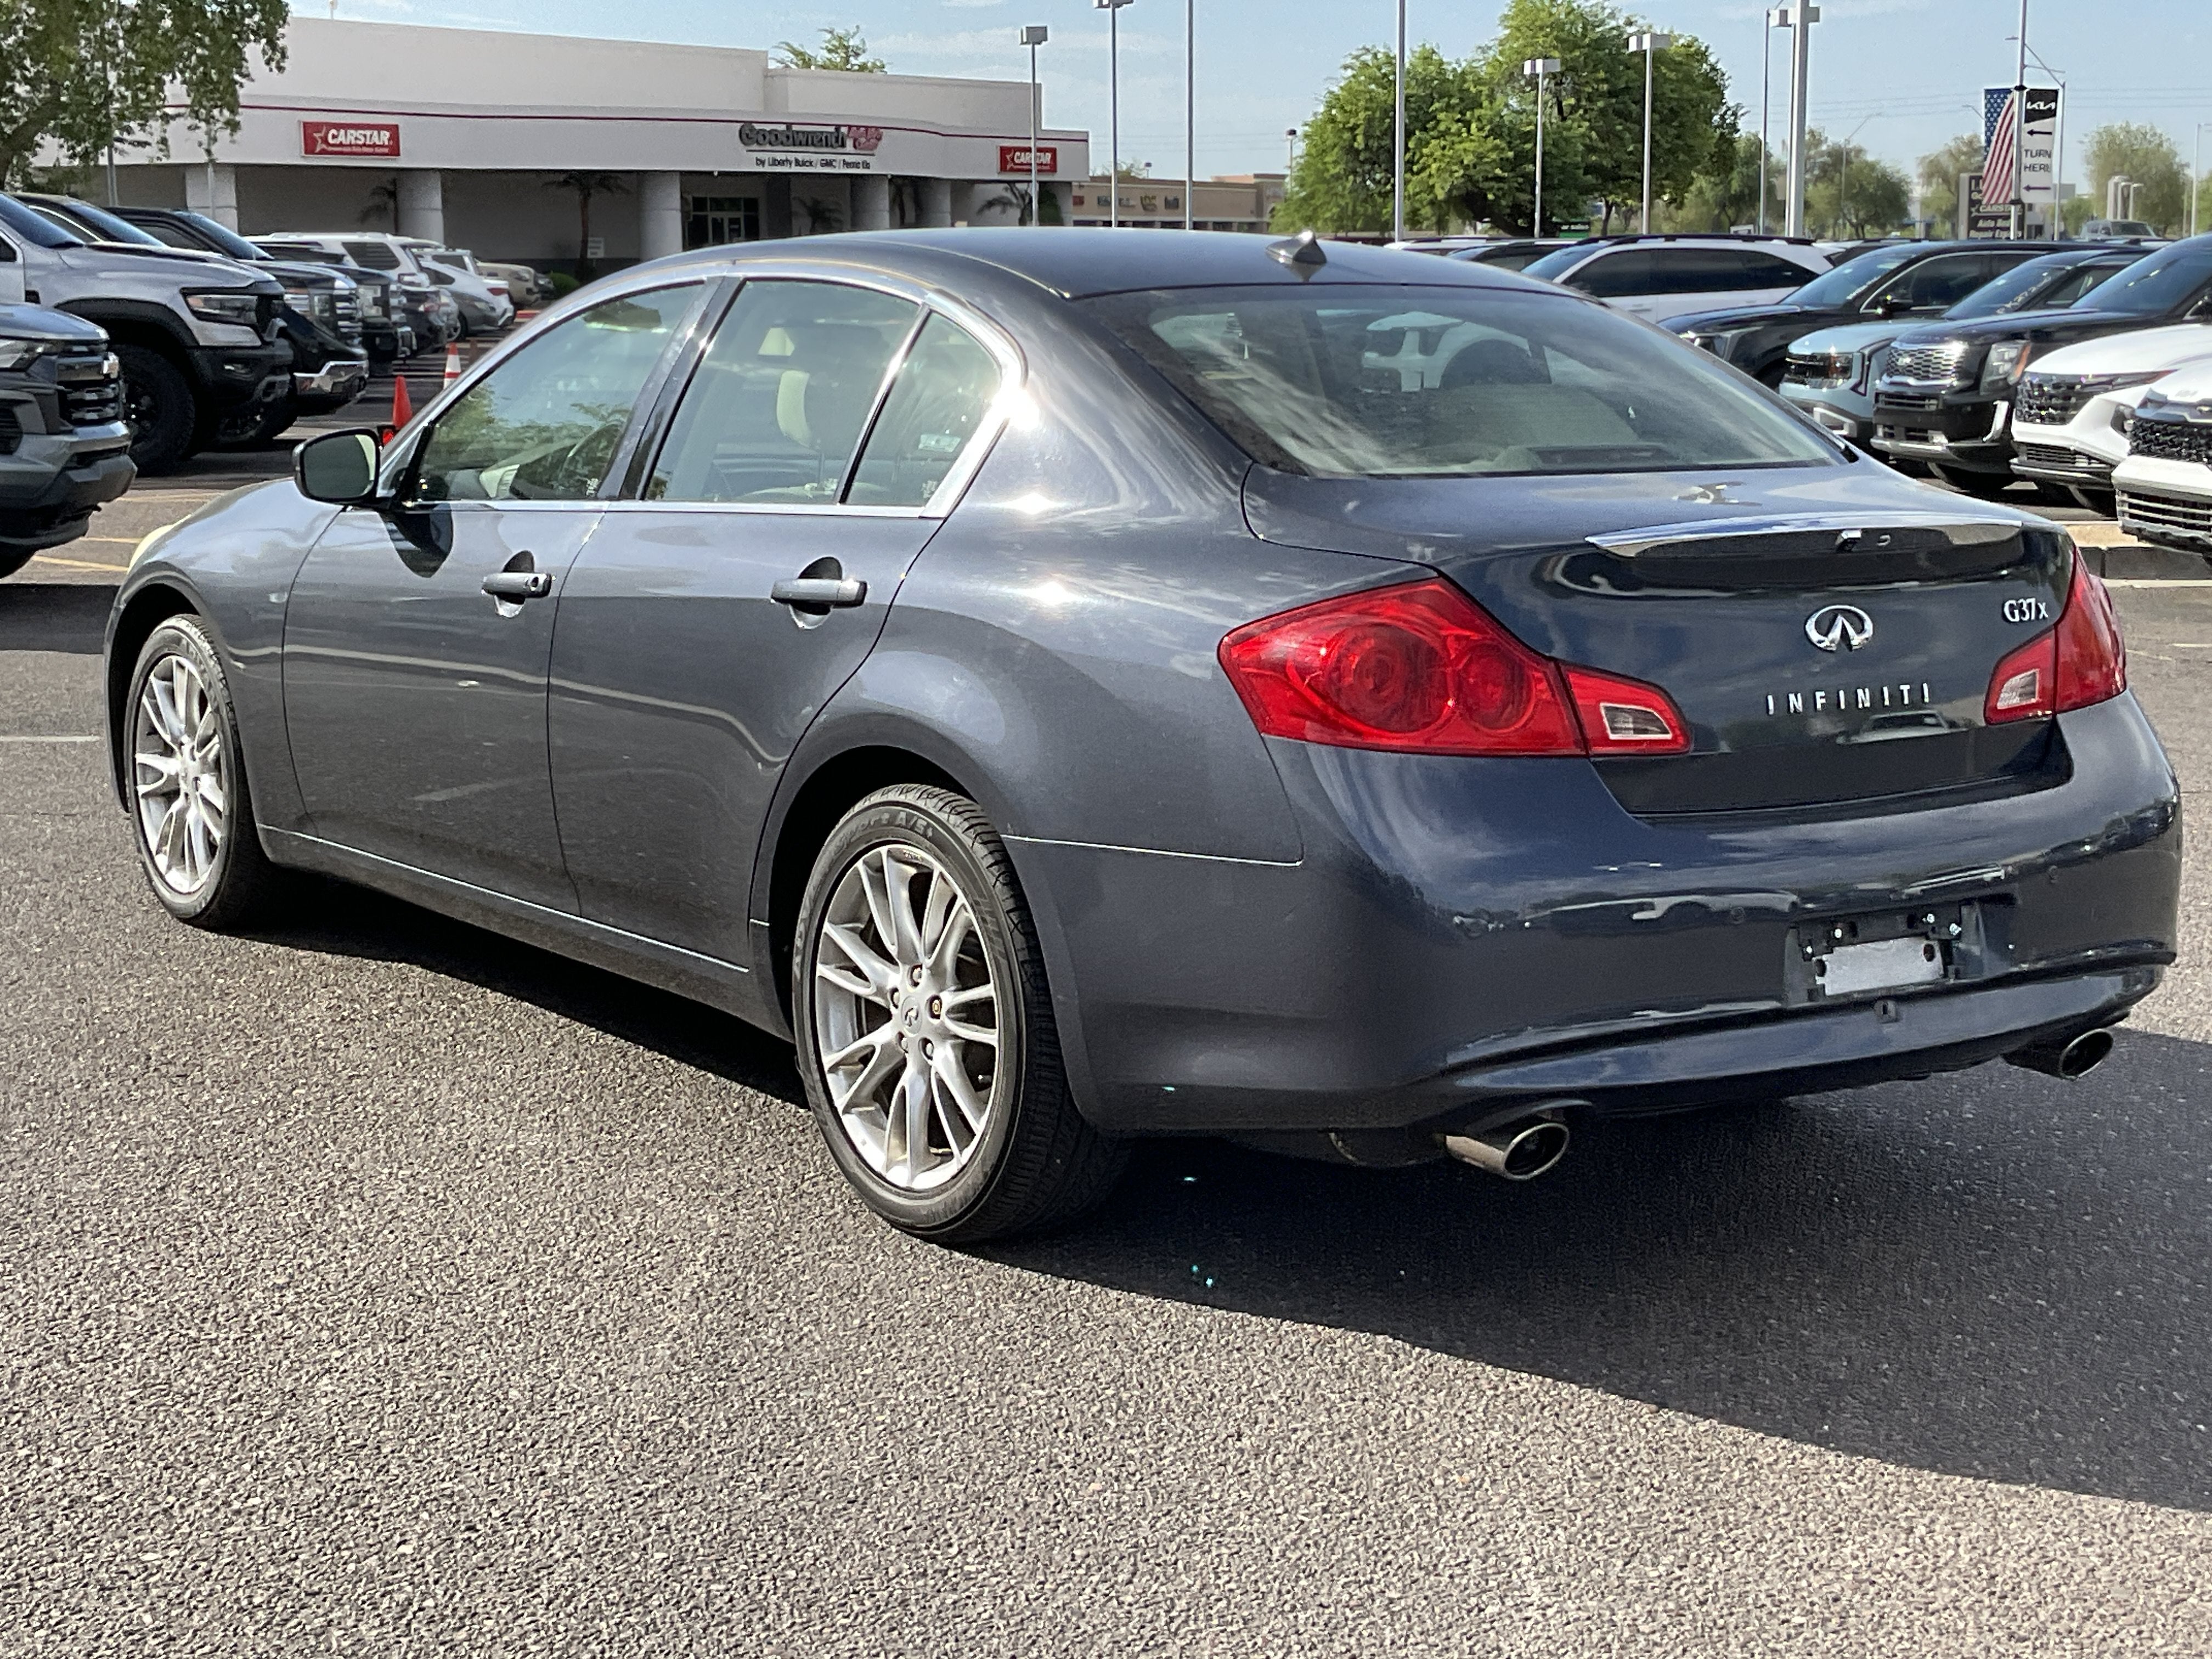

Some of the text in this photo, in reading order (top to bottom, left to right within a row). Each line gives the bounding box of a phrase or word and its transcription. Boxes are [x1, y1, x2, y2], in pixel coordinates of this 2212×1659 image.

[2026, 101, 2056, 110] KIA
[328, 128, 390, 145] CARSTAR
[739, 122, 847, 148] Goodwrench
[1014, 151, 1052, 164] CARTAR
[2024, 149, 2051, 159] TURN
[755, 157, 766, 167] by
[768, 156, 793, 168] Liberty
[794, 157, 814, 167] Buick
[2003, 598, 2049, 622] G37x
[1766, 682, 1929, 714] INFINITI
